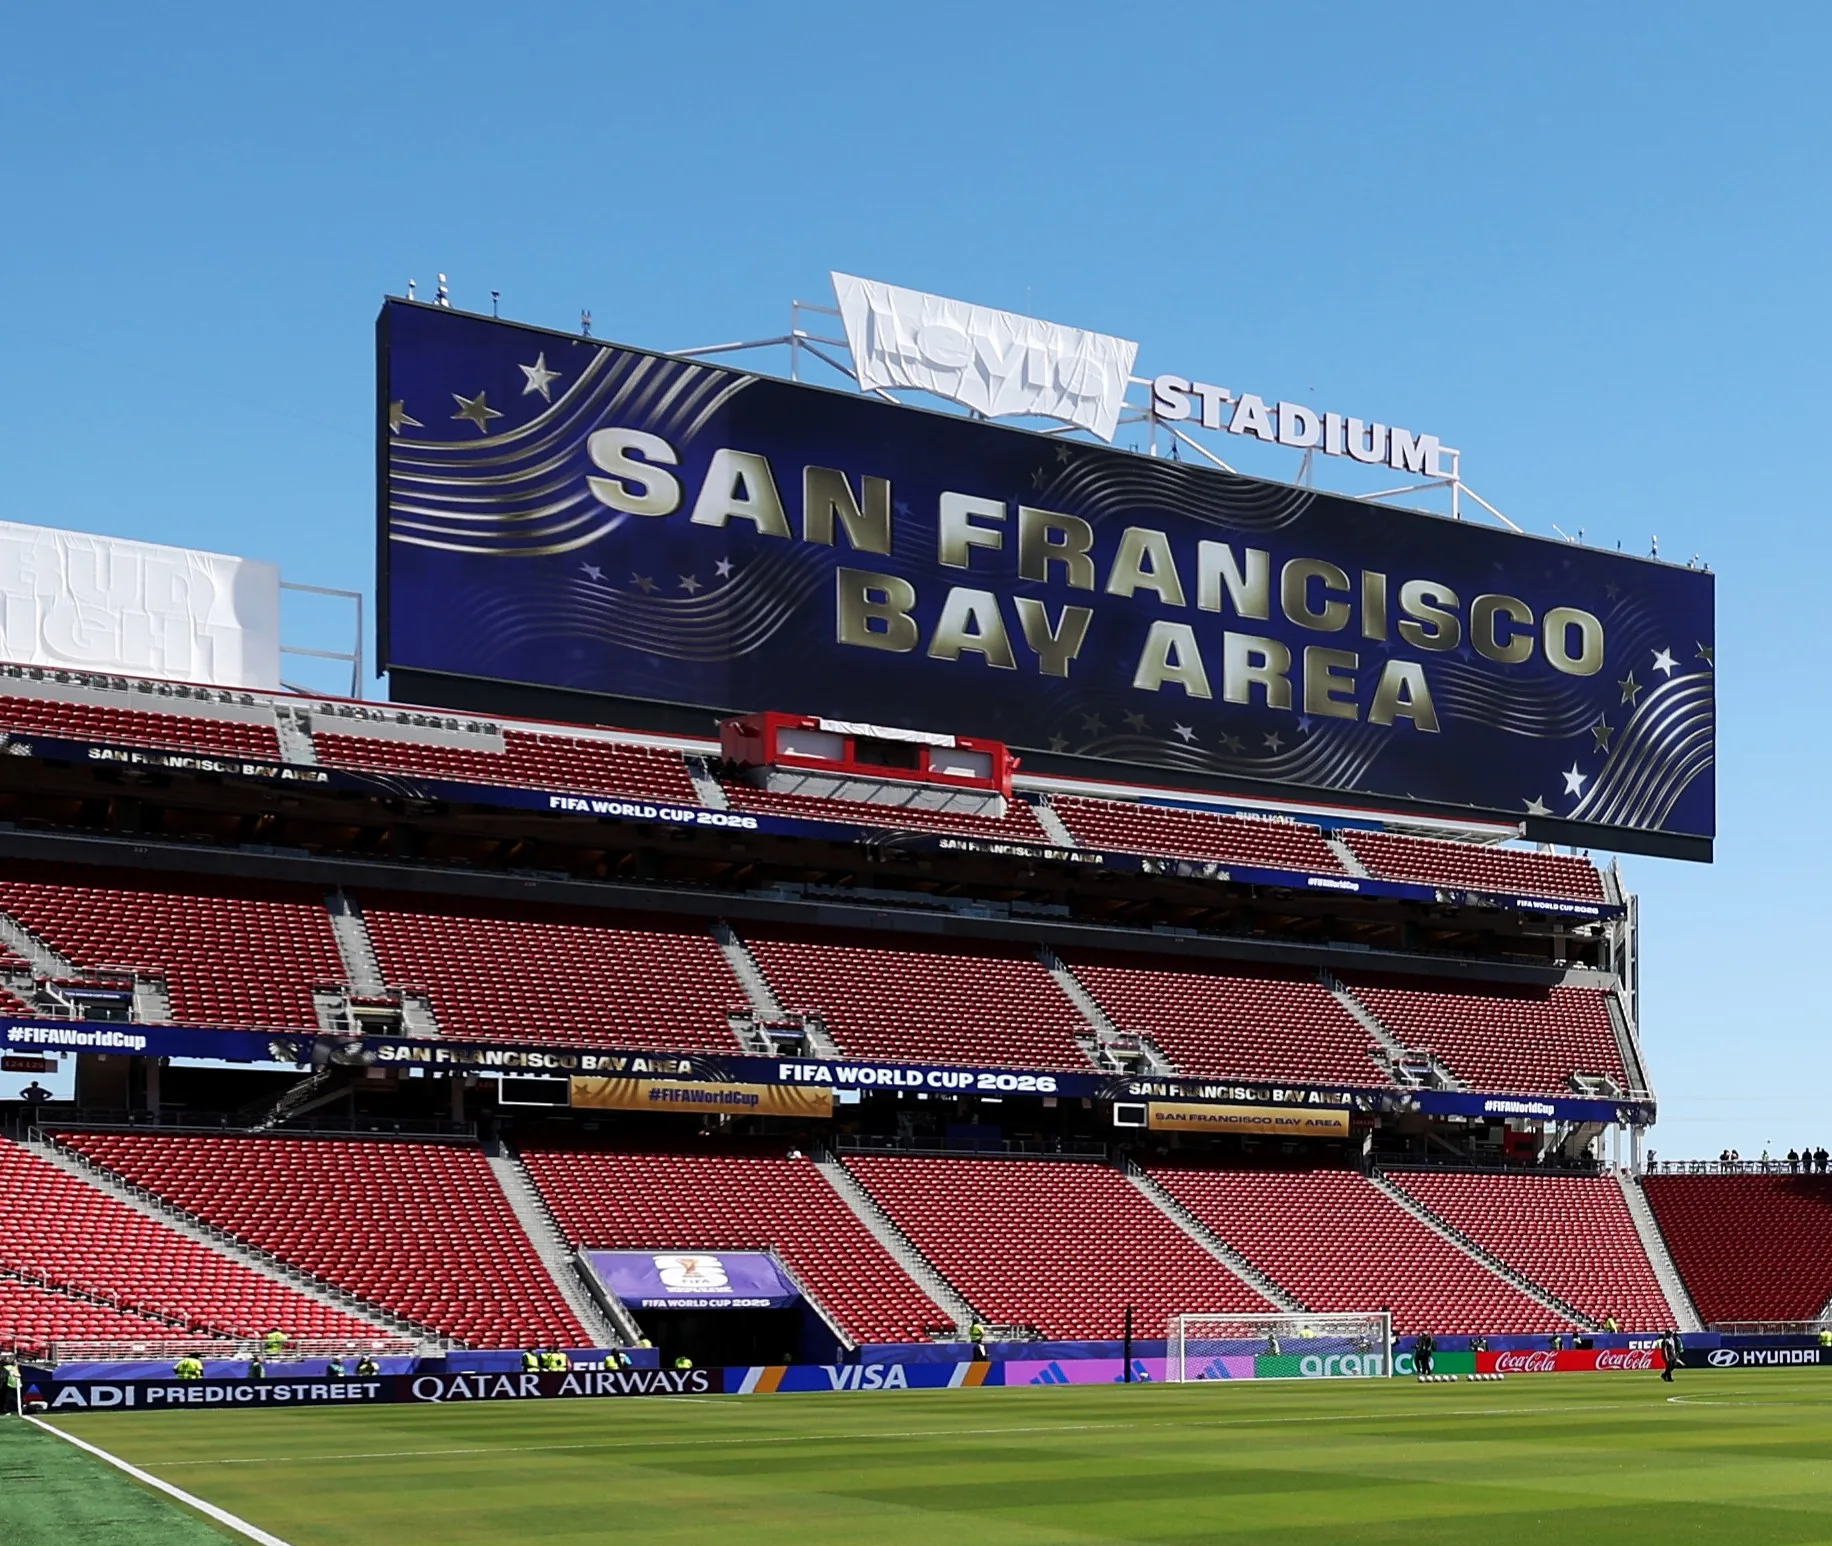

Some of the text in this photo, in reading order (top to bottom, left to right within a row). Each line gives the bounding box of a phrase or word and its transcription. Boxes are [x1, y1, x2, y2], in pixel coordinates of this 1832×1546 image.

[1152, 374, 1440, 477] STADIUM
[586, 428, 1607, 734] SAN FRANCISCO BAY AREA
[88, 748, 328, 783] SAN FRANCISCO BAY AREA
[550, 796, 758, 829] FIFA WORLD CUP 2026
[940, 839, 1104, 864] SAN FRANCISCO BAY AREA
[1516, 899, 1599, 914] FIFA WORLD CUP 2026
[8, 1026, 146, 1050] #FIFAWorldCup
[378, 1046, 691, 1074] SAN FRANCISCO BAY AREA
[779, 1063, 1057, 1093] FIFA WORLD CUP 2026
[648, 1088, 759, 1107] #FIFAWorldCup
[1129, 1082, 1352, 1105] SAN FRANCISCO BAY AREA
[1155, 1112, 1186, 1121] SAN
[1189, 1114, 1271, 1124] FRANCISCO
[1275, 1117, 1301, 1125] BAY
[1484, 1100, 1554, 1116] #FIFAWorldCup
[642, 1299, 770, 1307] FIFA WORLD CUP 2026
[1496, 1351, 1558, 1371] Coca-Cola
[1596, 1350, 1654, 1370] Coca-Cola
[1743, 1349, 1820, 1364] HYUNDAI
[412, 1371, 709, 1402] QATAR AIRWAYS
[819, 1364, 908, 1390] VISA
[52, 1383, 380, 1406] ADI PREDICTSTREET
